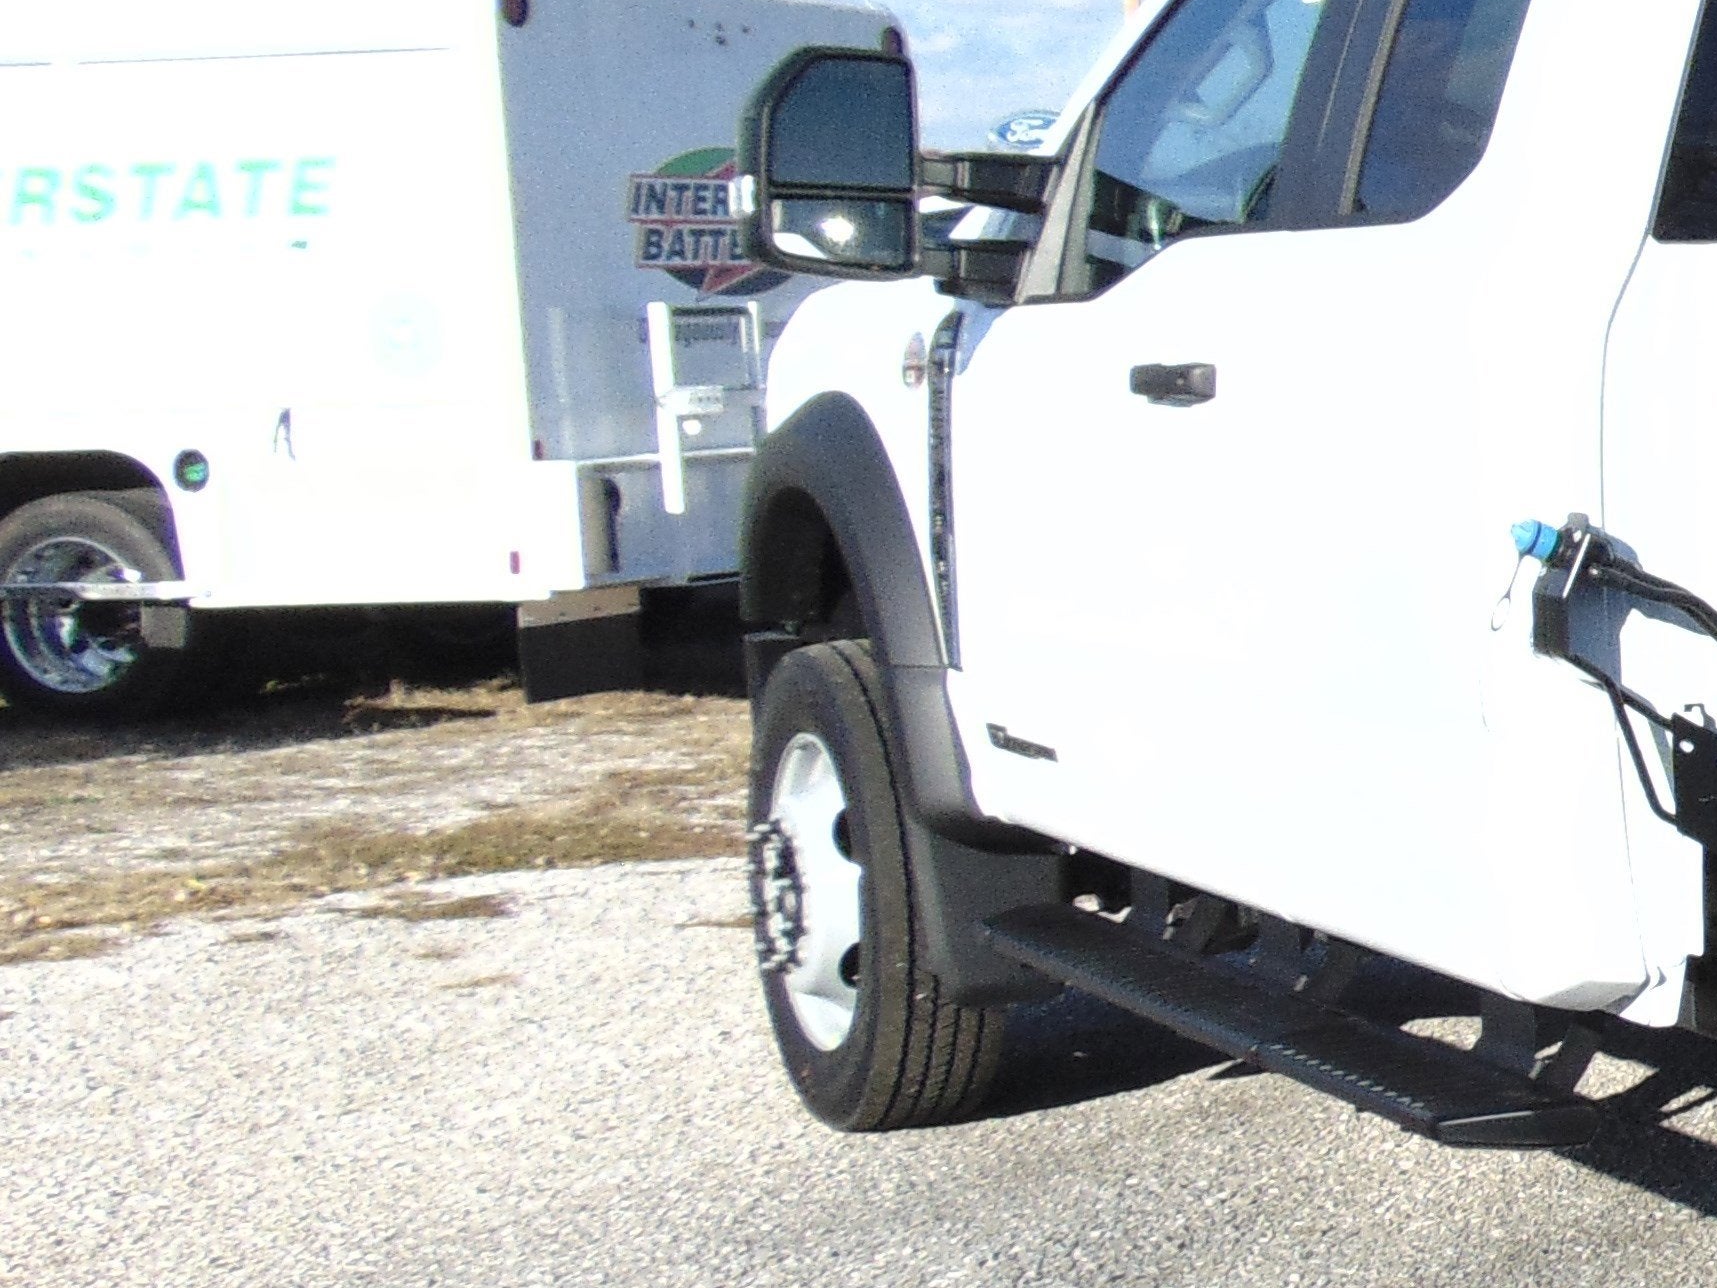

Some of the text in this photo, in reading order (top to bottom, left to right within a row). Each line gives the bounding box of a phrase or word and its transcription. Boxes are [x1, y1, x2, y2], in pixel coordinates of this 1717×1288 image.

[2, 156, 337, 226] RSTATE
[630, 181, 729, 215] INTER
[642, 227, 744, 261] BATTE
